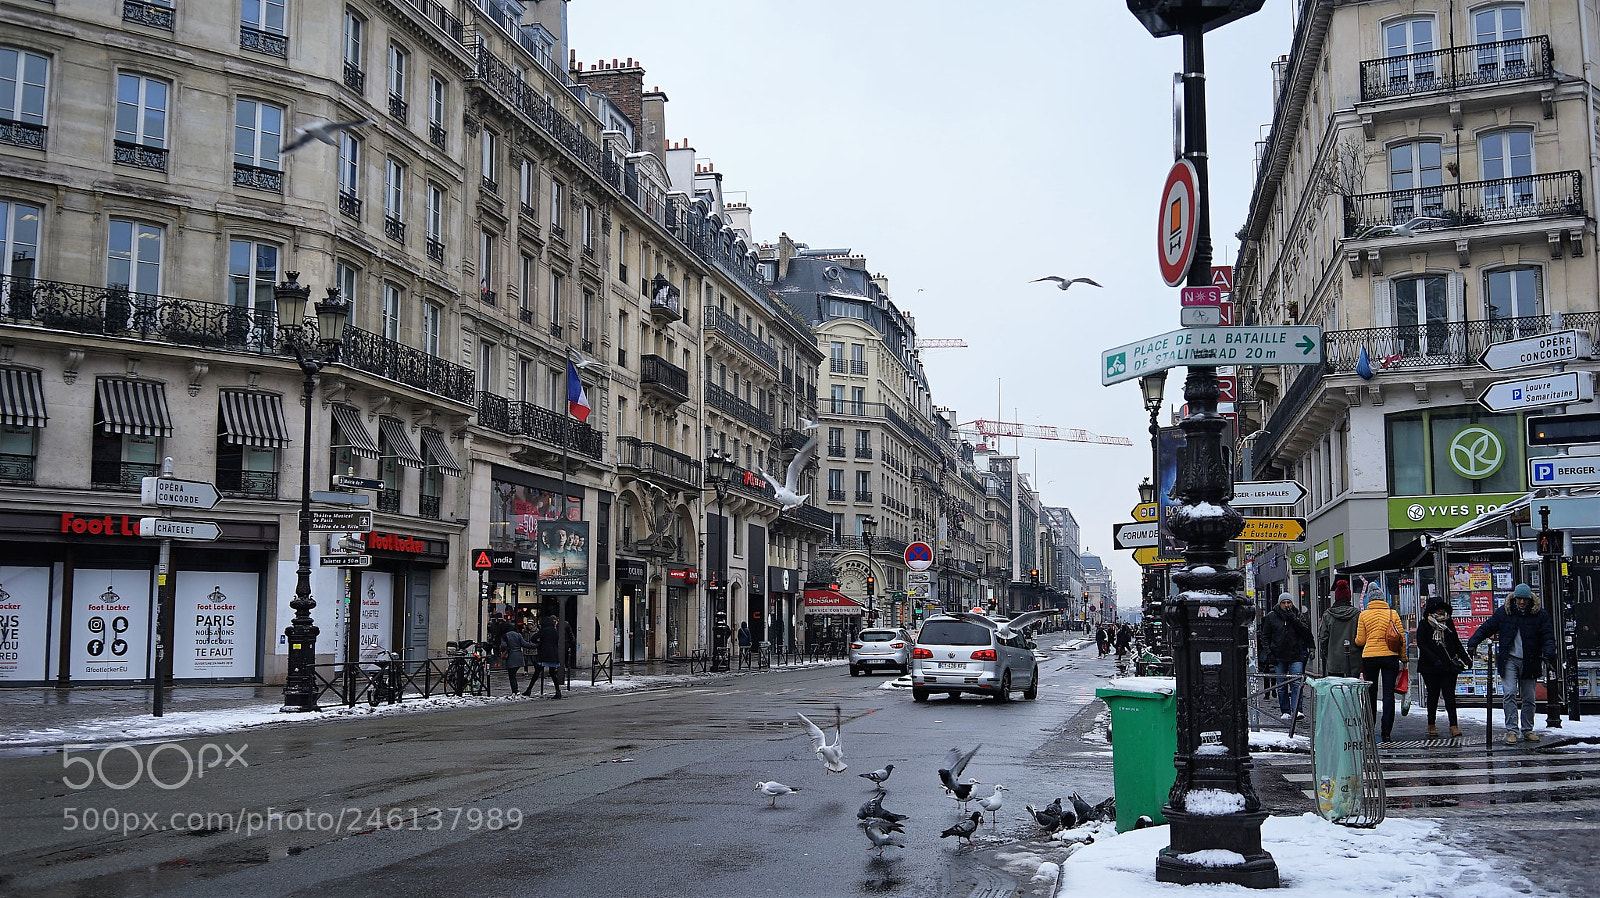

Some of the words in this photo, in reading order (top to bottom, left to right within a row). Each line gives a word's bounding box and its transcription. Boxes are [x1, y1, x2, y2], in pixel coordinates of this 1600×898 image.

[1184, 291, 1194, 301] N
[1208, 291, 1217, 301] S
[1133, 338, 1169, 357] PLACE
[1175, 333, 1192, 346] DE
[1200, 332, 1216, 344] LA
[1225, 332, 1287, 344] BATAILLE
[1540, 336, 1571, 348] OPÉRA
[1134, 358, 1148, 371] DE
[1245, 348, 1262, 359] 20
[1265, 350, 1276, 359] m
[1520, 346, 1572, 362] CONCORDE
[1526, 382, 1551, 392] Louvre
[1526, 390, 1573, 402] Samaritaine
[1558, 466, 1596, 475] BERGER
[159, 482, 184, 493] OPÉRA
[158, 494, 199, 504] CONCORDE
[1428, 505, 1470, 516] YVES
[62, 513, 114, 535] Foot
[157, 524, 195, 535] CHÂTELET
[1122, 530, 1148, 540] FORUM
[368, 531, 395, 550] Foot
[396, 534, 424, 553] Locker
[196, 615, 234, 626] PARIS
[195, 648, 206, 656] TE
[210, 648, 234, 656] FAUT
